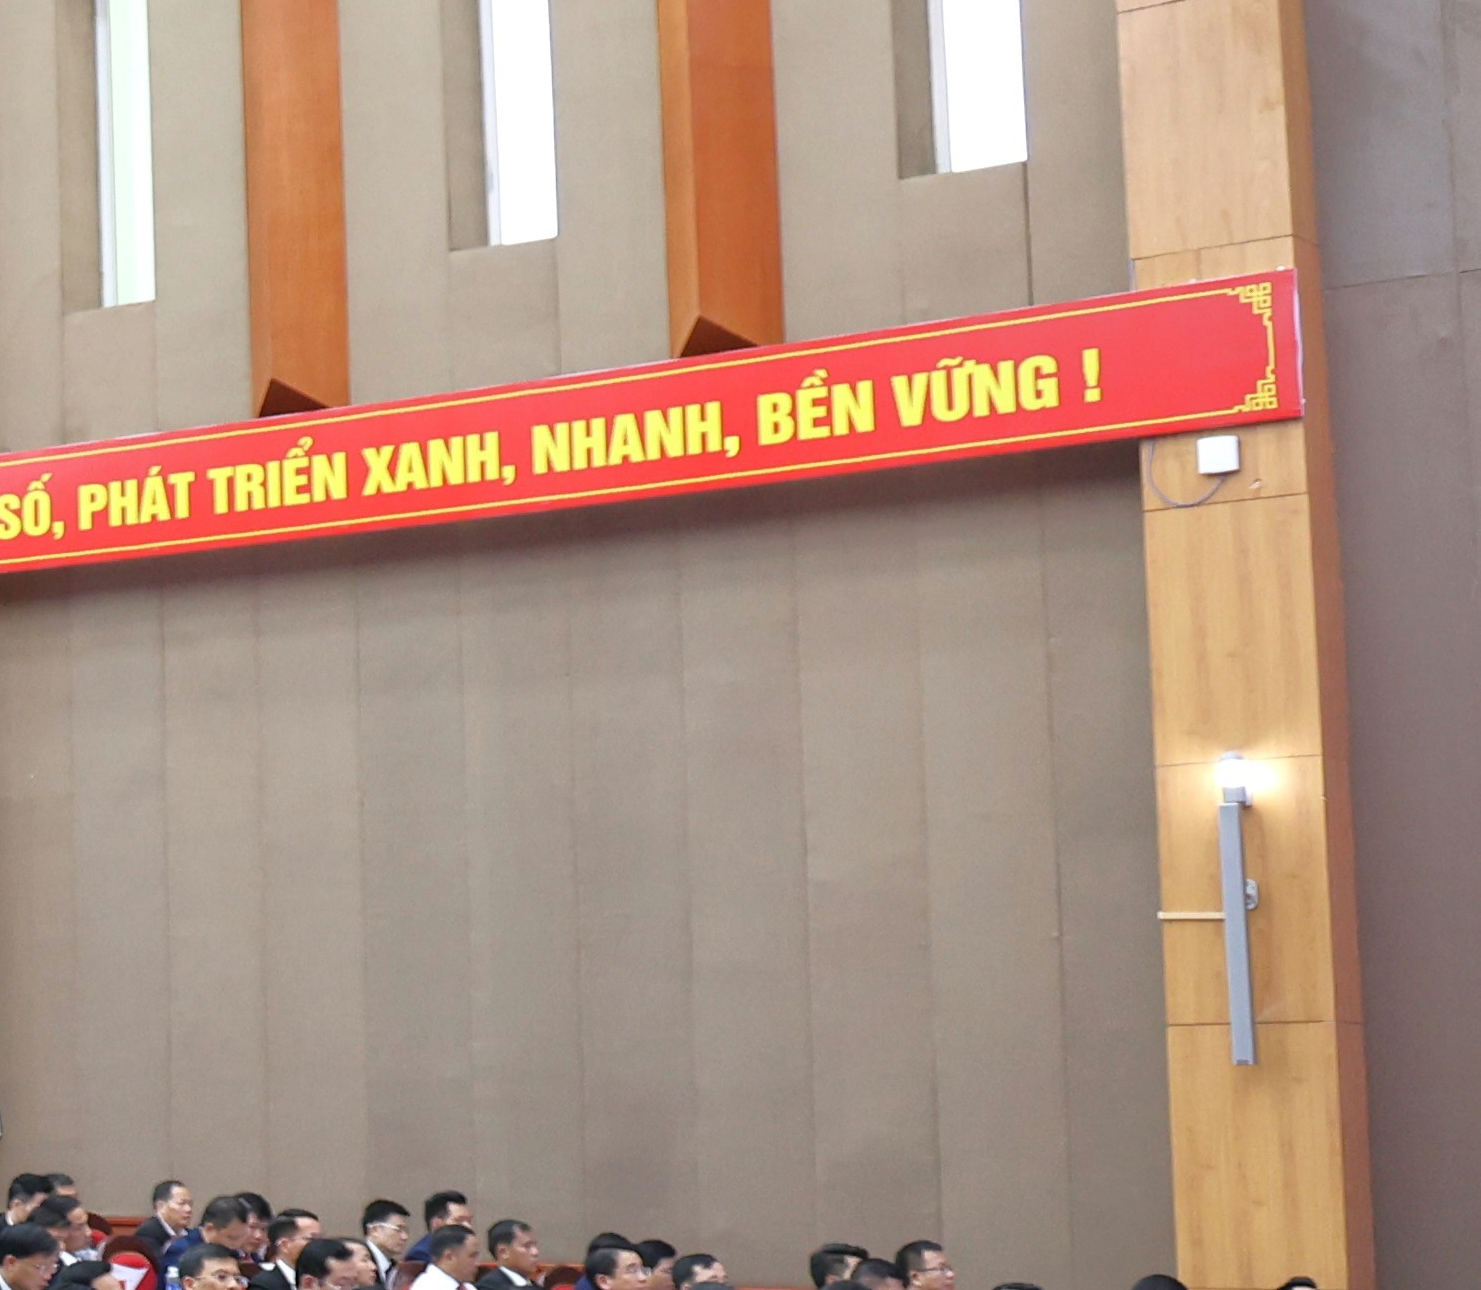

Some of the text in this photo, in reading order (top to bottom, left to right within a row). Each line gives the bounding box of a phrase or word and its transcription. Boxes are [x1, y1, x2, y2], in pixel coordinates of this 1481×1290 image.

[78, 453, 195, 530] PHÁT
[207, 435, 347, 515] TRIỂN
[362, 431, 516, 496] XANH,
[532, 401, 740, 475] NHANH,
[757, 363, 875, 446] BỀN
[891, 355, 1059, 427] VỮNG
[1083, 348, 1101, 403] !
